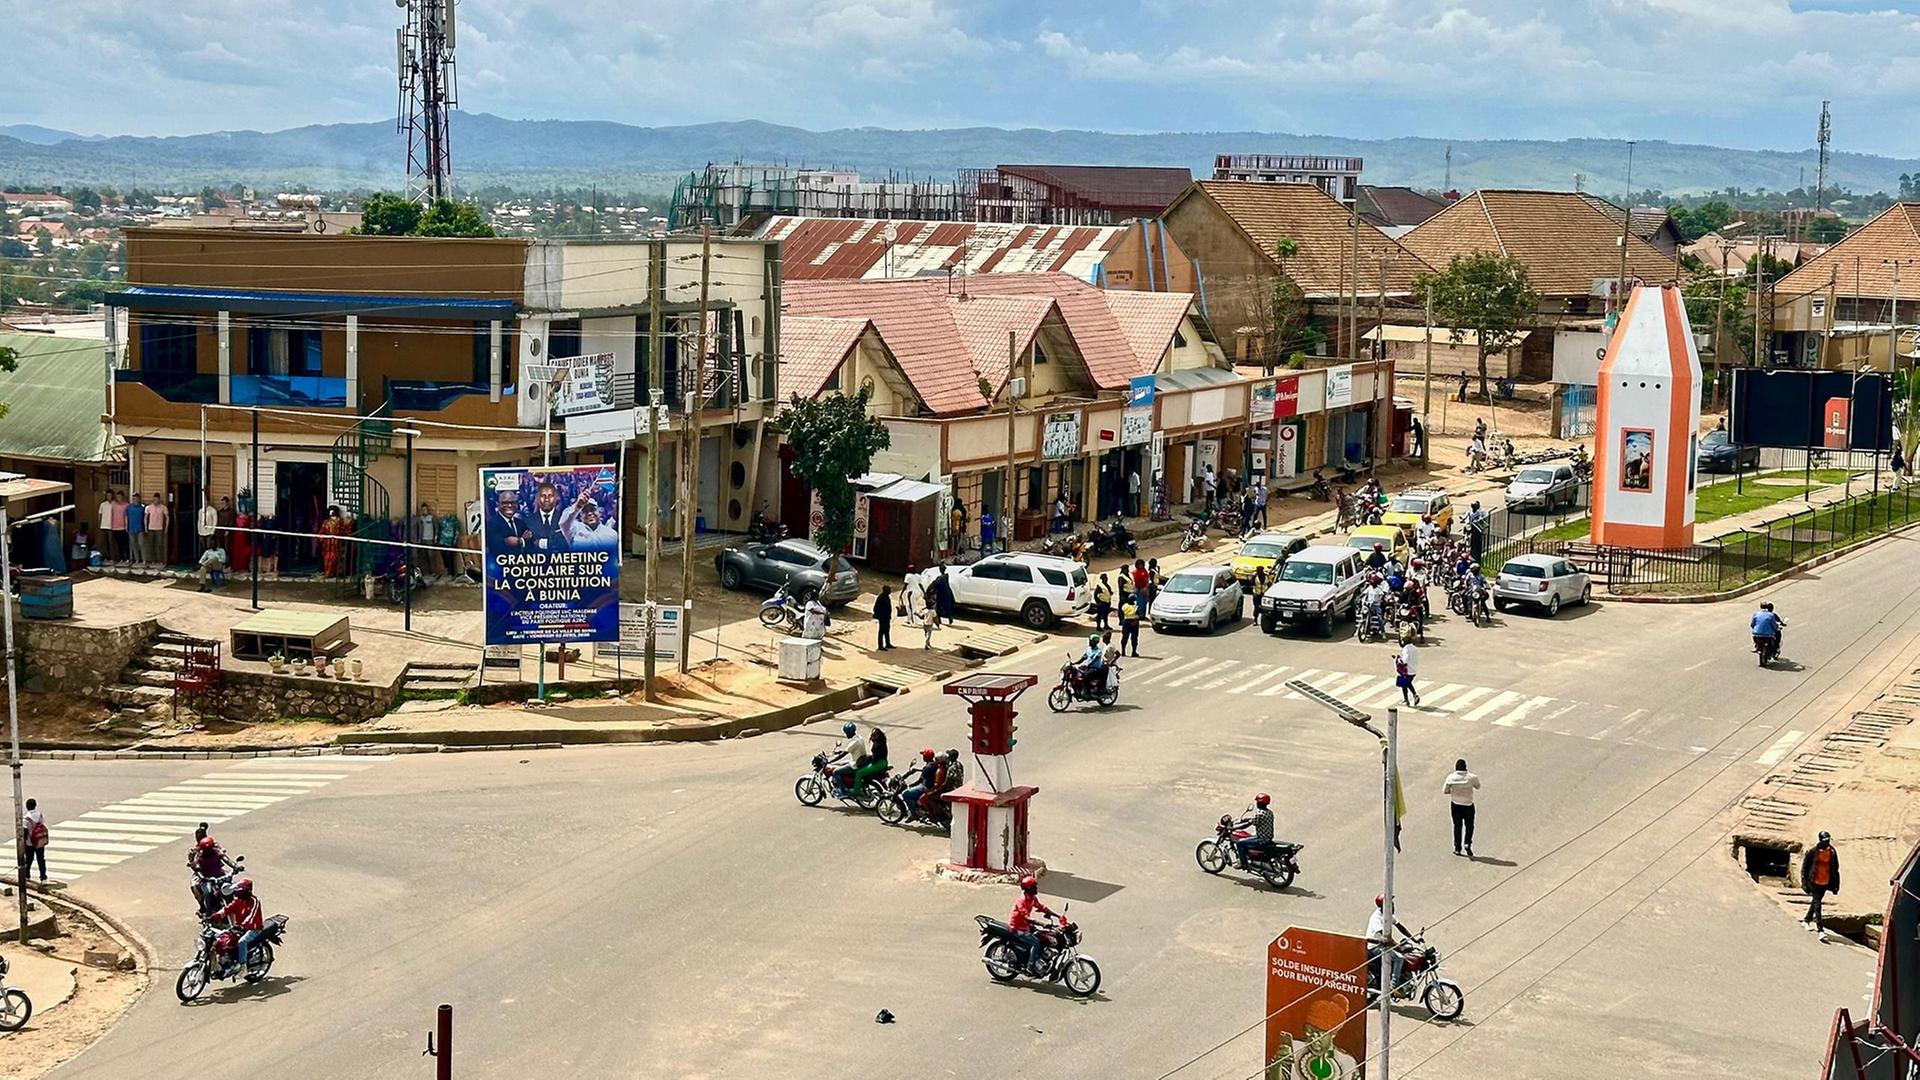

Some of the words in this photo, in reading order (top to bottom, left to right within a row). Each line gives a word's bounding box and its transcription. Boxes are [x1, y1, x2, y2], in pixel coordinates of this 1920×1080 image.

[496, 554, 546, 566] GRAND
[550, 551, 609, 564] MEETING
[503, 565, 577, 577] POPULAIRE
[579, 564, 603, 575] SUR
[494, 580, 511, 590] LA
[515, 576, 611, 590] CONSTITUTION
[540, 589, 581, 601] BUNIA
[1272, 957, 1300, 971] SOLDE
[1301, 963, 1357, 983] INSUFFISANT
[1272, 967, 1295, 980] POUR
[1296, 973, 1323, 986] ENVOI
[1323, 979, 1359, 994] ARGENT
